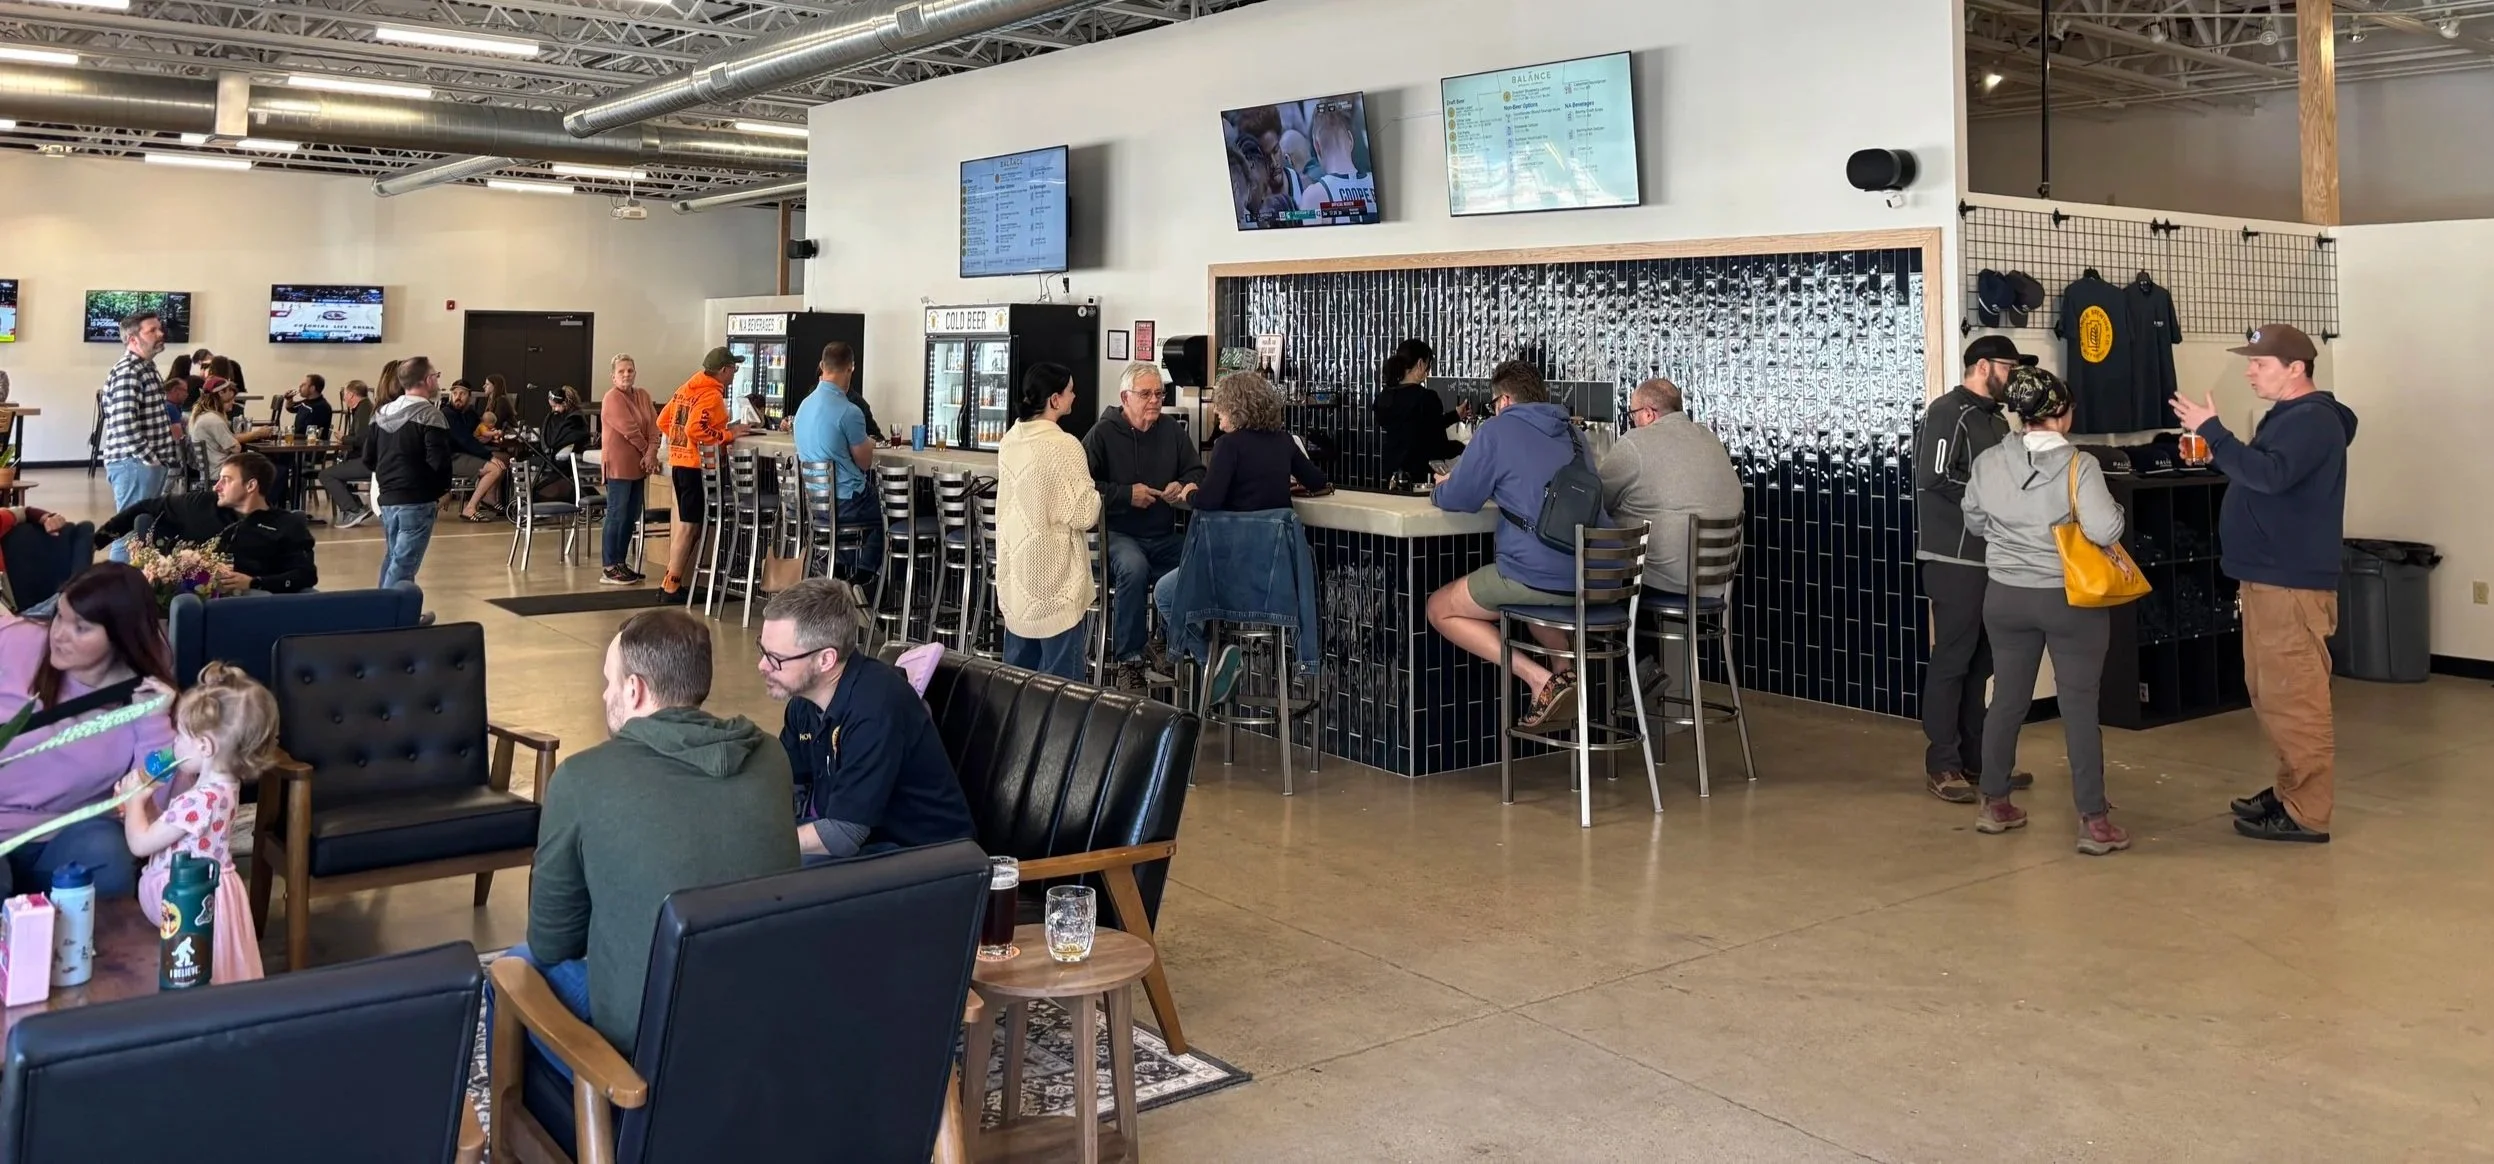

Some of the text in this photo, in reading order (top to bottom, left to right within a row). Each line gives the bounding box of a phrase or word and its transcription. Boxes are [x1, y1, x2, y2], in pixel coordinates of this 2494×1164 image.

[1511, 71, 1551, 84] BALANCE
[747, 318, 774, 332] BEVERAGES
[945, 311, 987, 330] COLD BEER
[169, 968, 173, 979] I
